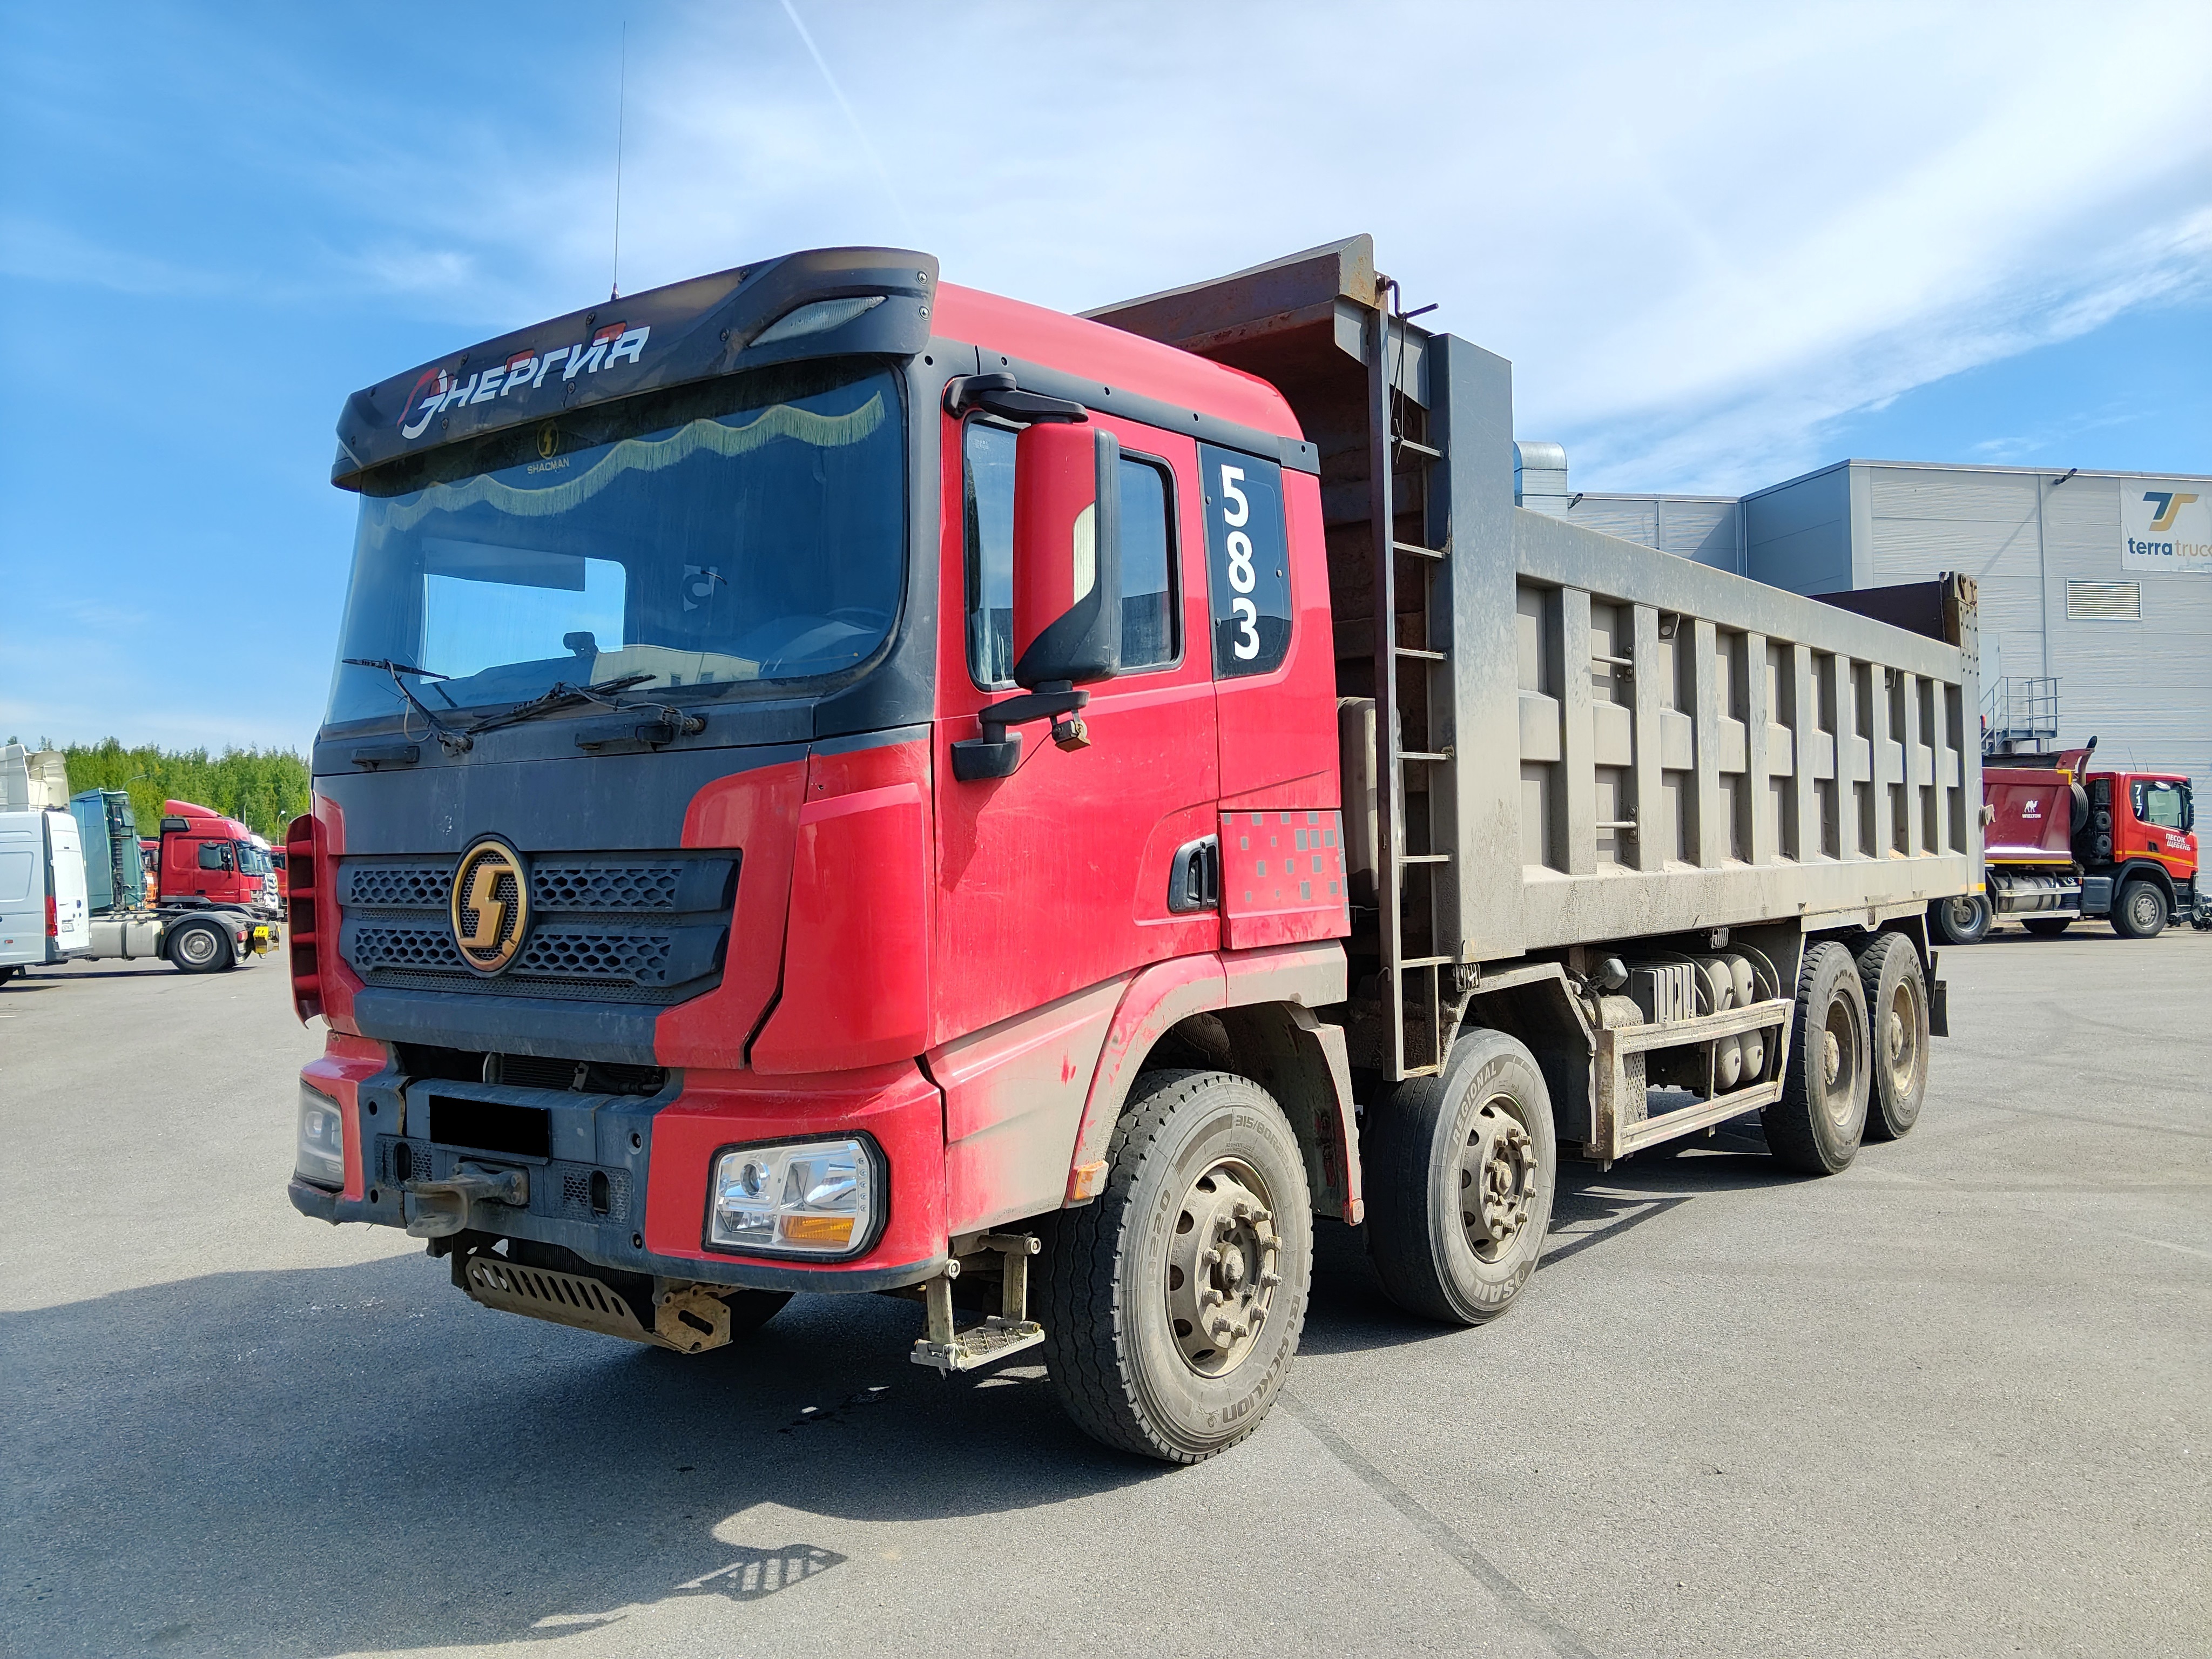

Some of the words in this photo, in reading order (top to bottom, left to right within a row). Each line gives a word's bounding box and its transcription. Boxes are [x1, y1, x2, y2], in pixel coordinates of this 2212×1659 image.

[399, 326, 651, 439] ЭНЕРГИЯ
[527, 457, 570, 474] SHACMAN
[1220, 464, 1260, 660] 583
[2135, 785, 2143, 817] 717
[2166, 833, 2186, 844] ПЕСОК
[2167, 840, 2191, 851] ЩЕБЕНЬ
[1452, 1061, 1497, 1147] REGIONAL
